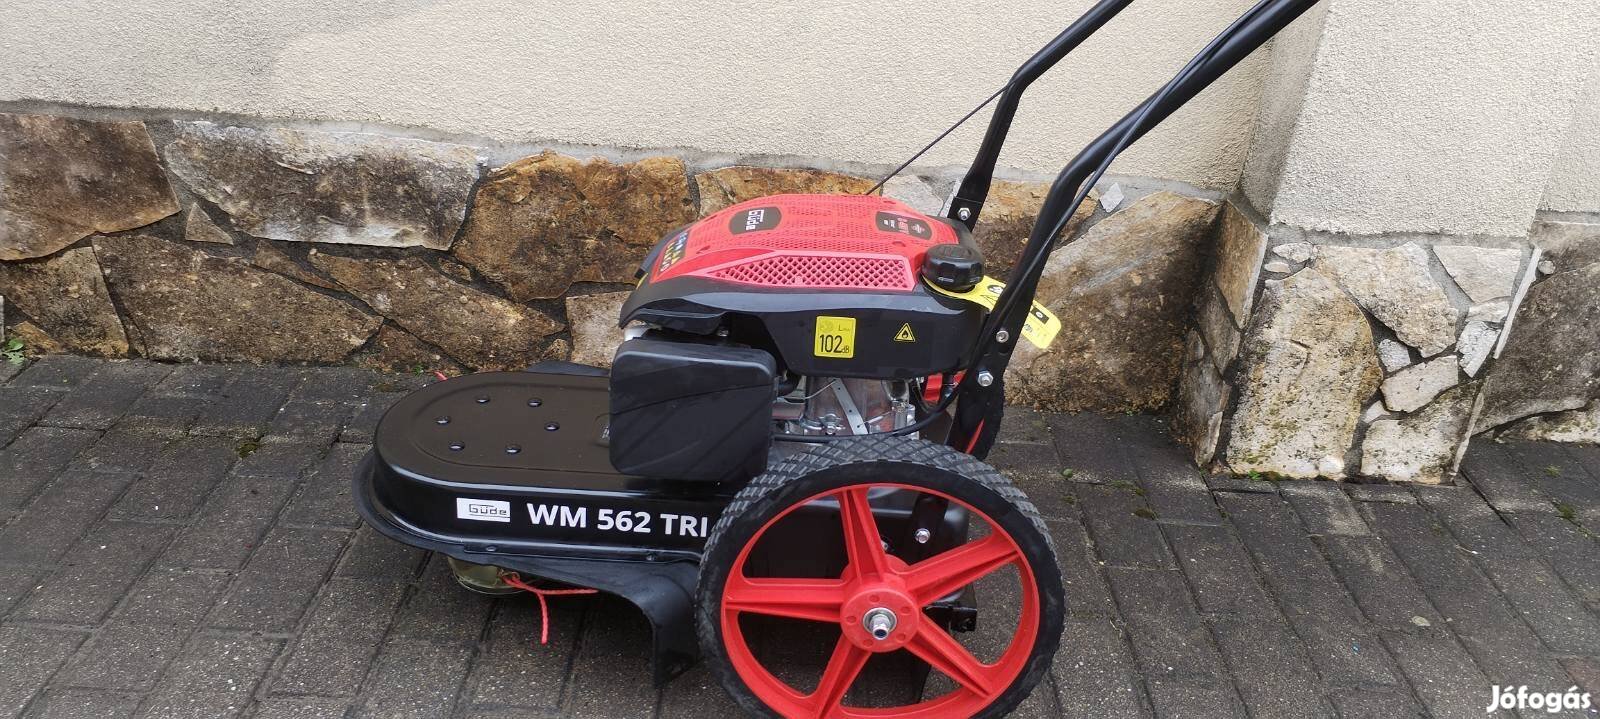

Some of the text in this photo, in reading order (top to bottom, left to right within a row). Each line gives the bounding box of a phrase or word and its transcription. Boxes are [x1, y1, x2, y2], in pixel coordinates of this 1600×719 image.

[819, 334, 843, 353] 102
[469, 503, 508, 516] Güde
[526, 502, 709, 538] WM 562 TRI
